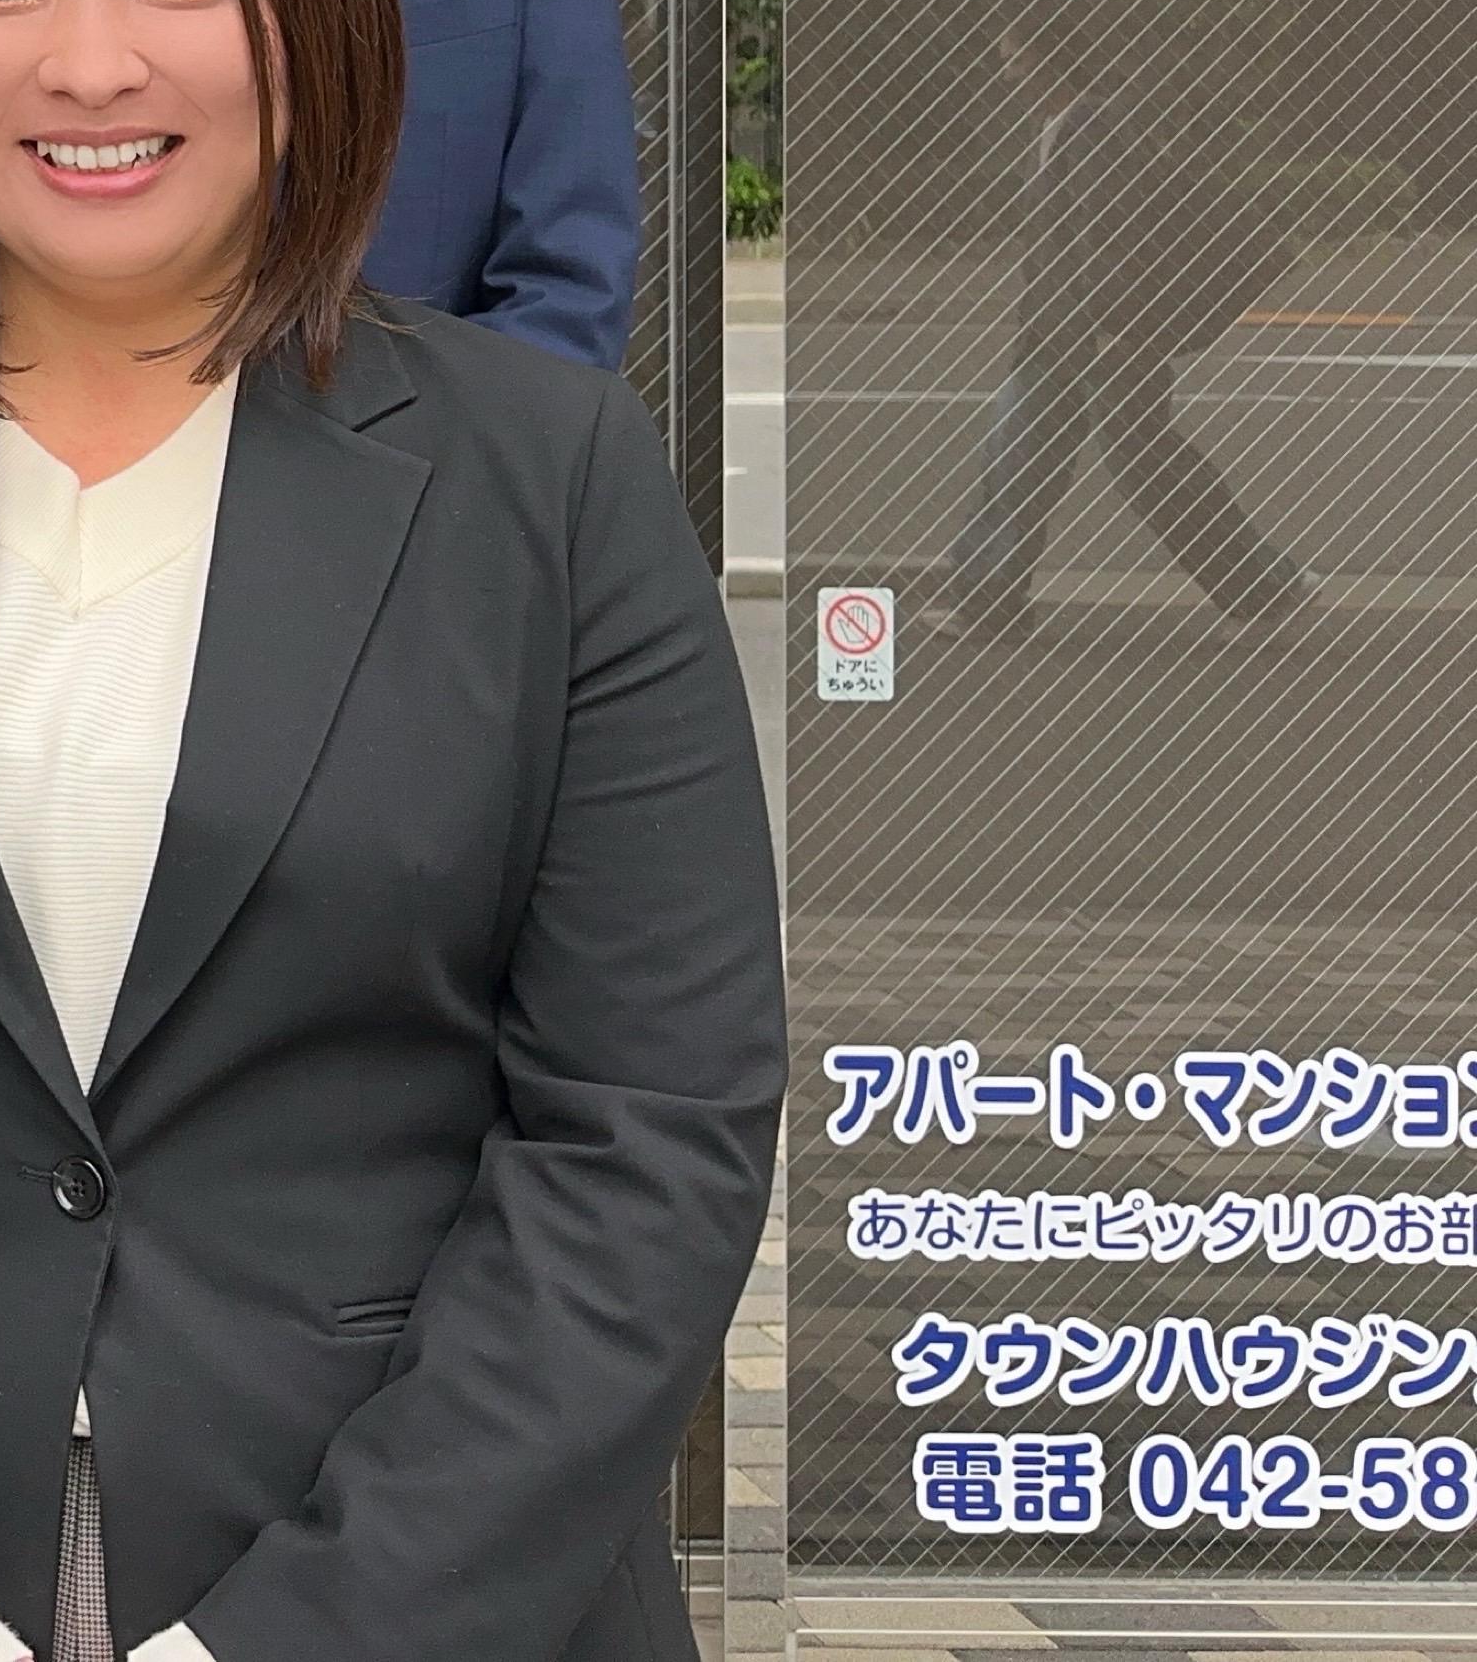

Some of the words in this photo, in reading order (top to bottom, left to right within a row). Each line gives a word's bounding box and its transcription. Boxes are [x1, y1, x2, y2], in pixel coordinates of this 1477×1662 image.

[827, 677, 885, 693] ちゅうい
[835, 658, 878, 674] ドアに
[824, 1041, 1477, 1148] アパート・マンショ
[915, 1433, 1103, 1533] 電話
[1130, 1434, 1477, 1532] 042-58
